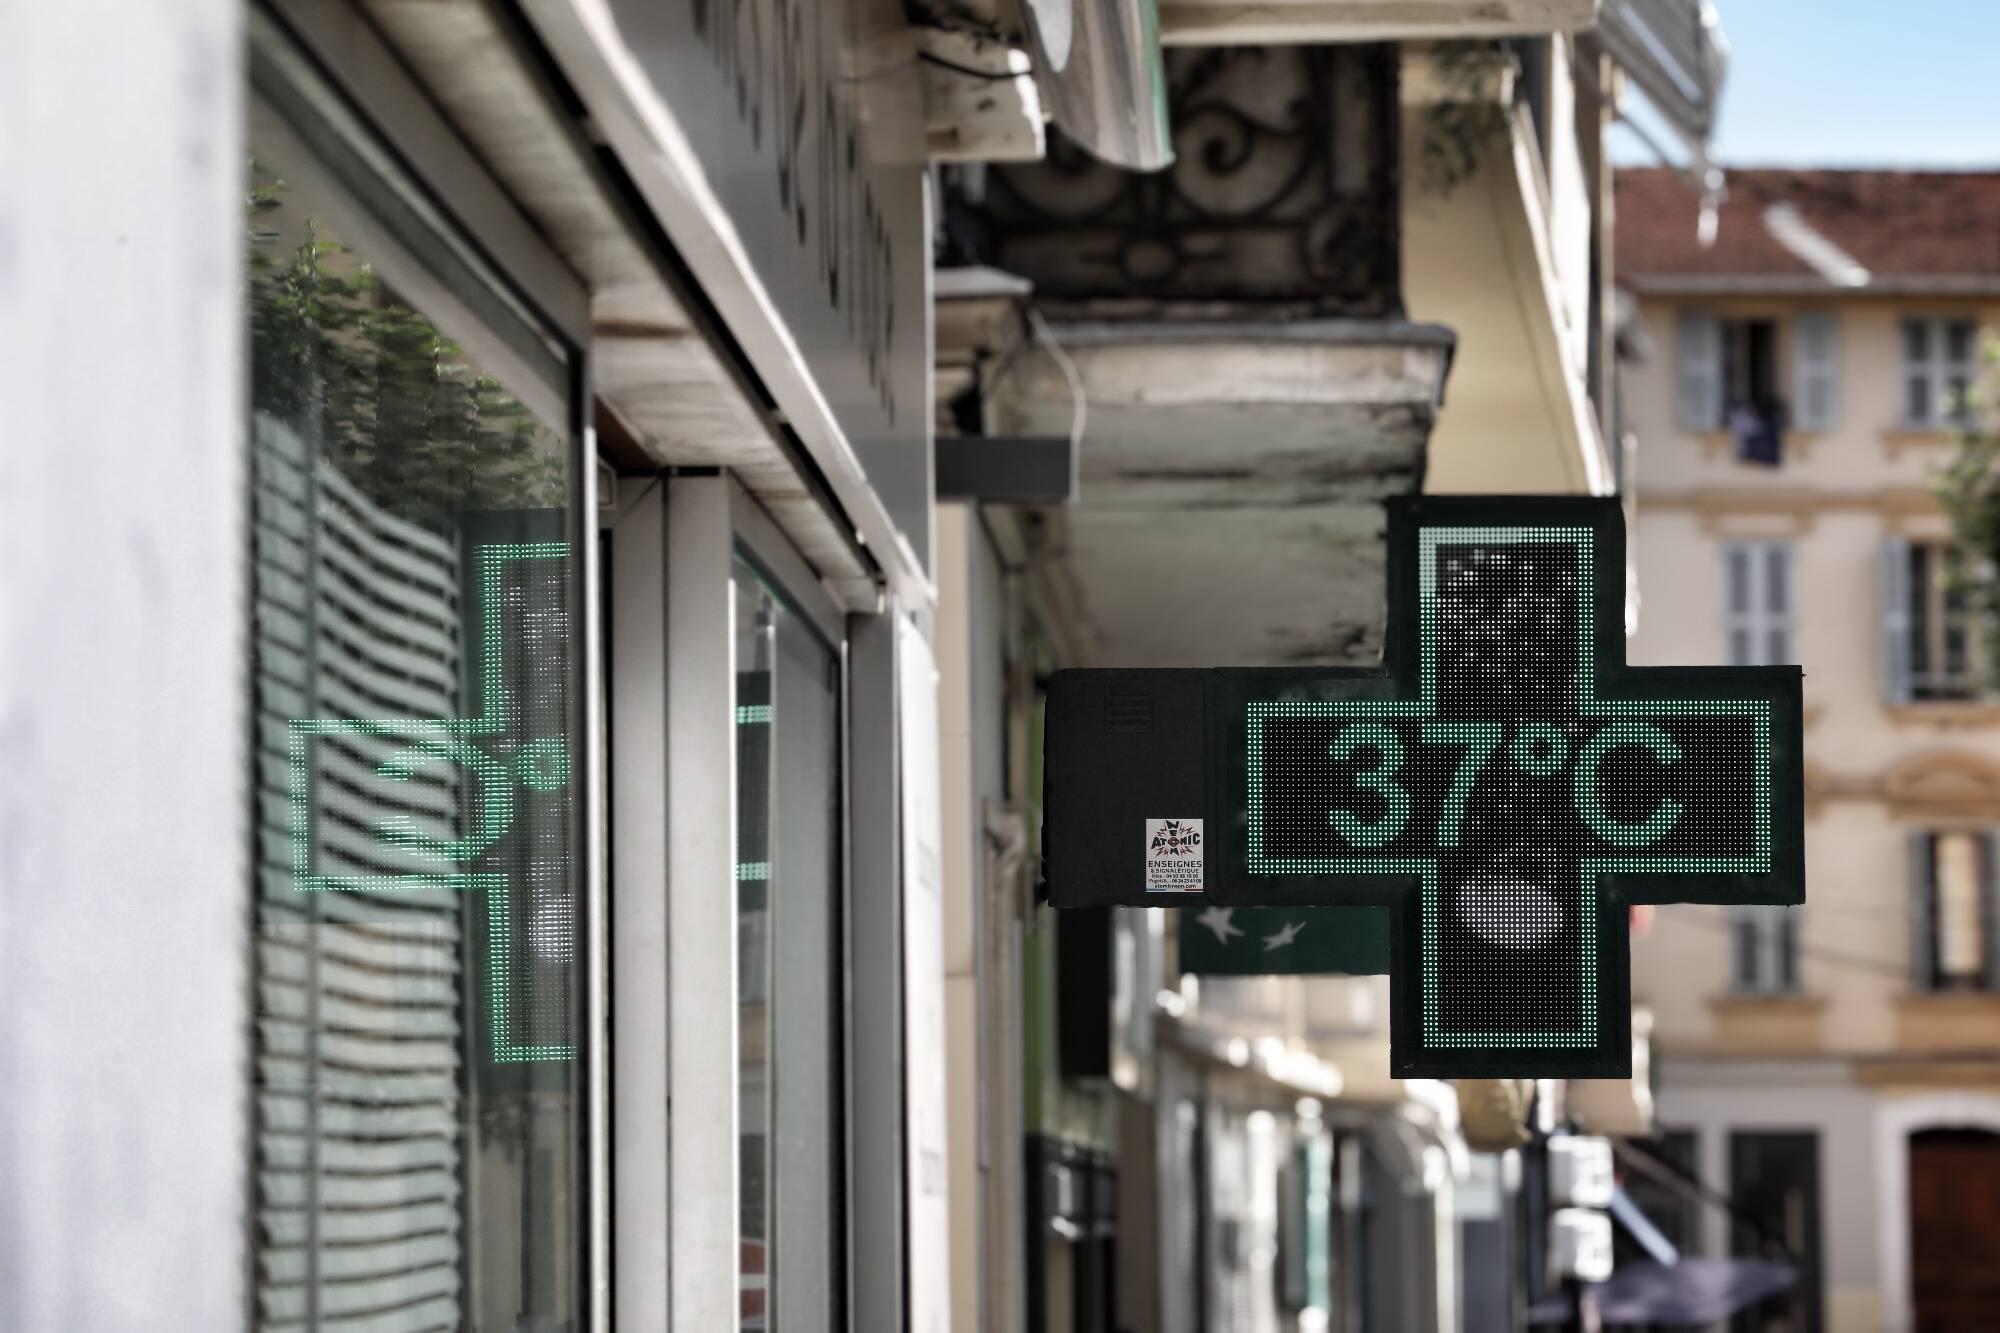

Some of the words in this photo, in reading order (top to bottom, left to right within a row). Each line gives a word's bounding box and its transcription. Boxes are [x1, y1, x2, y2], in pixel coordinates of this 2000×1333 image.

[1328, 721, 1683, 847] 37°C
[1150, 832, 1201, 849] ATOMIC
[1148, 860, 1202, 868] ENSEIGNES
